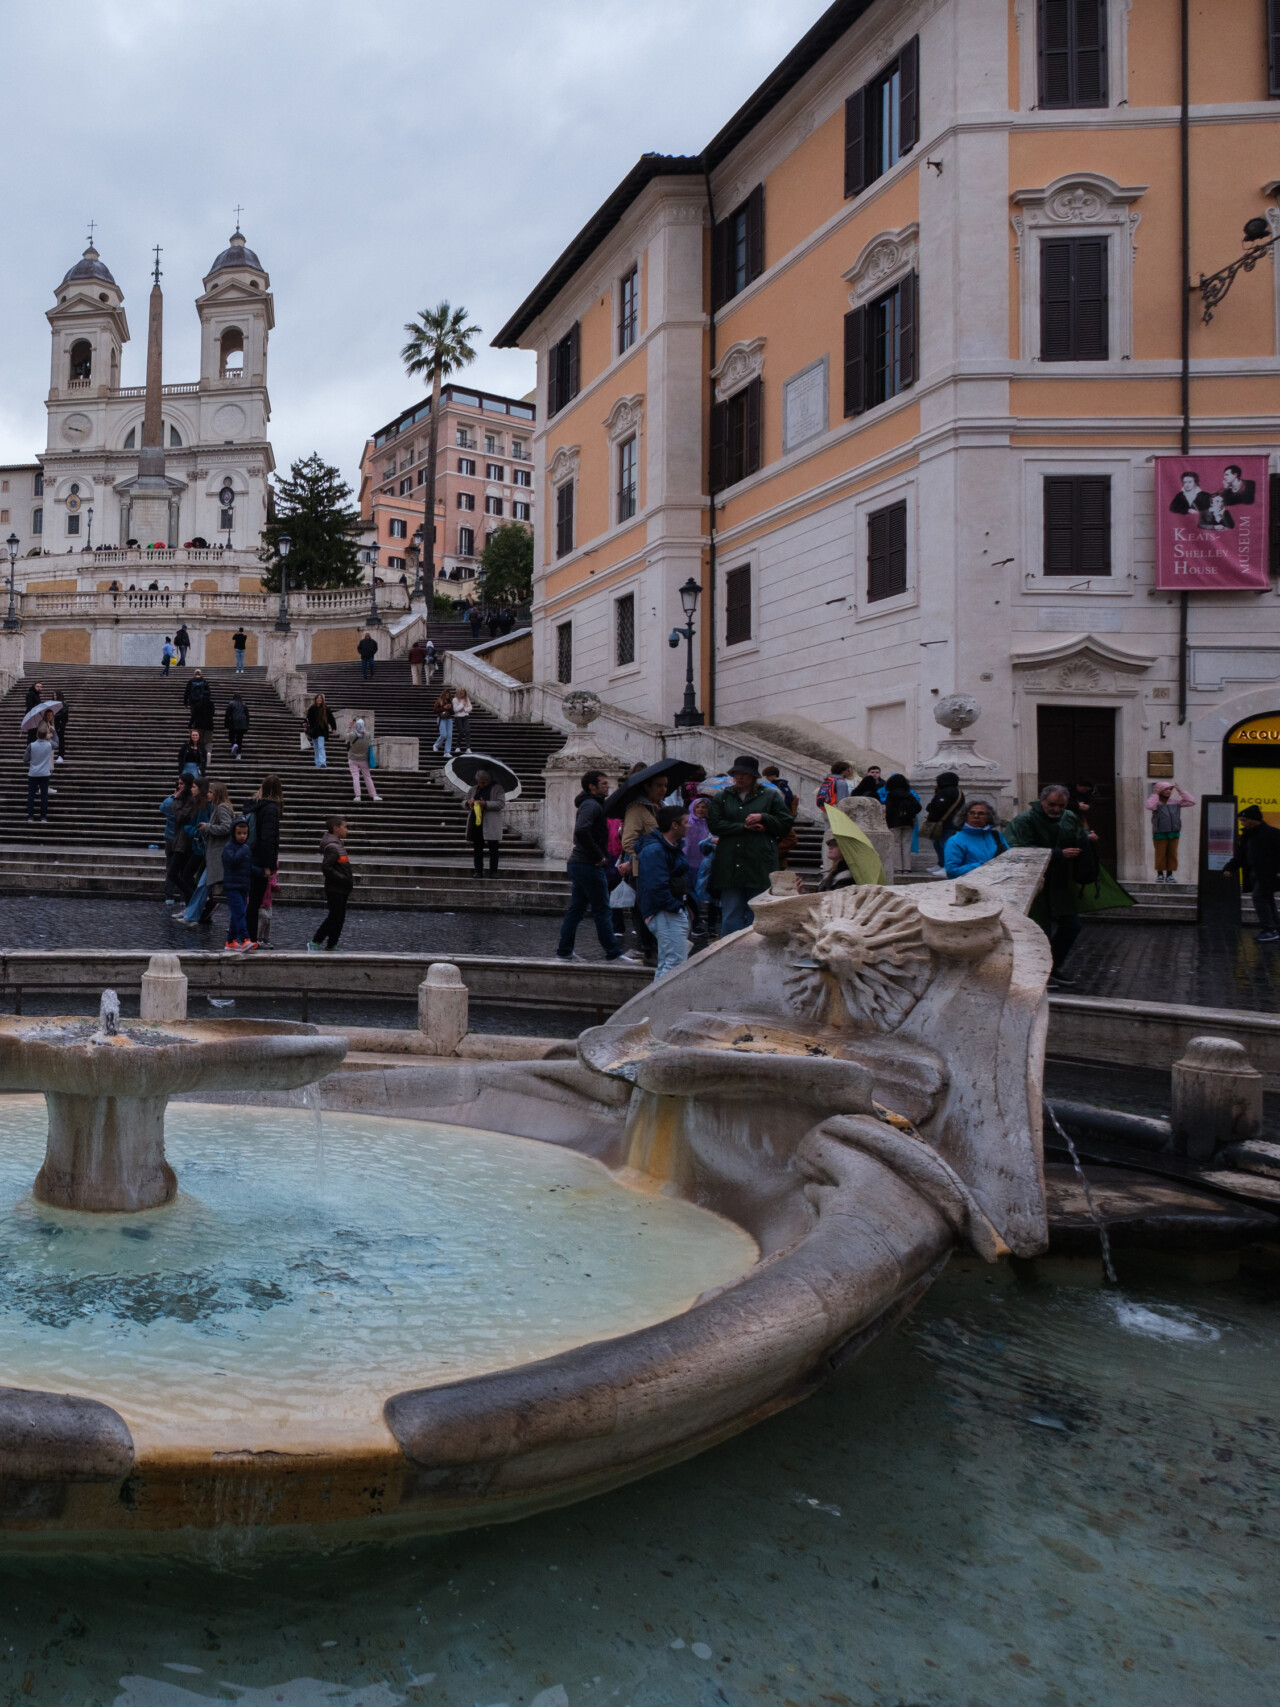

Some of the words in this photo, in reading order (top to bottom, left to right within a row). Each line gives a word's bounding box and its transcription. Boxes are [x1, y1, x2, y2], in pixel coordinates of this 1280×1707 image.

[1173, 544, 1229, 558] SHELLEY
[1238, 515, 1250, 574] MUSEUM
[1173, 560, 1218, 575] HOUSE
[1238, 730, 1280, 740] ACQU
[1240, 797, 1278, 805] ACQUA
